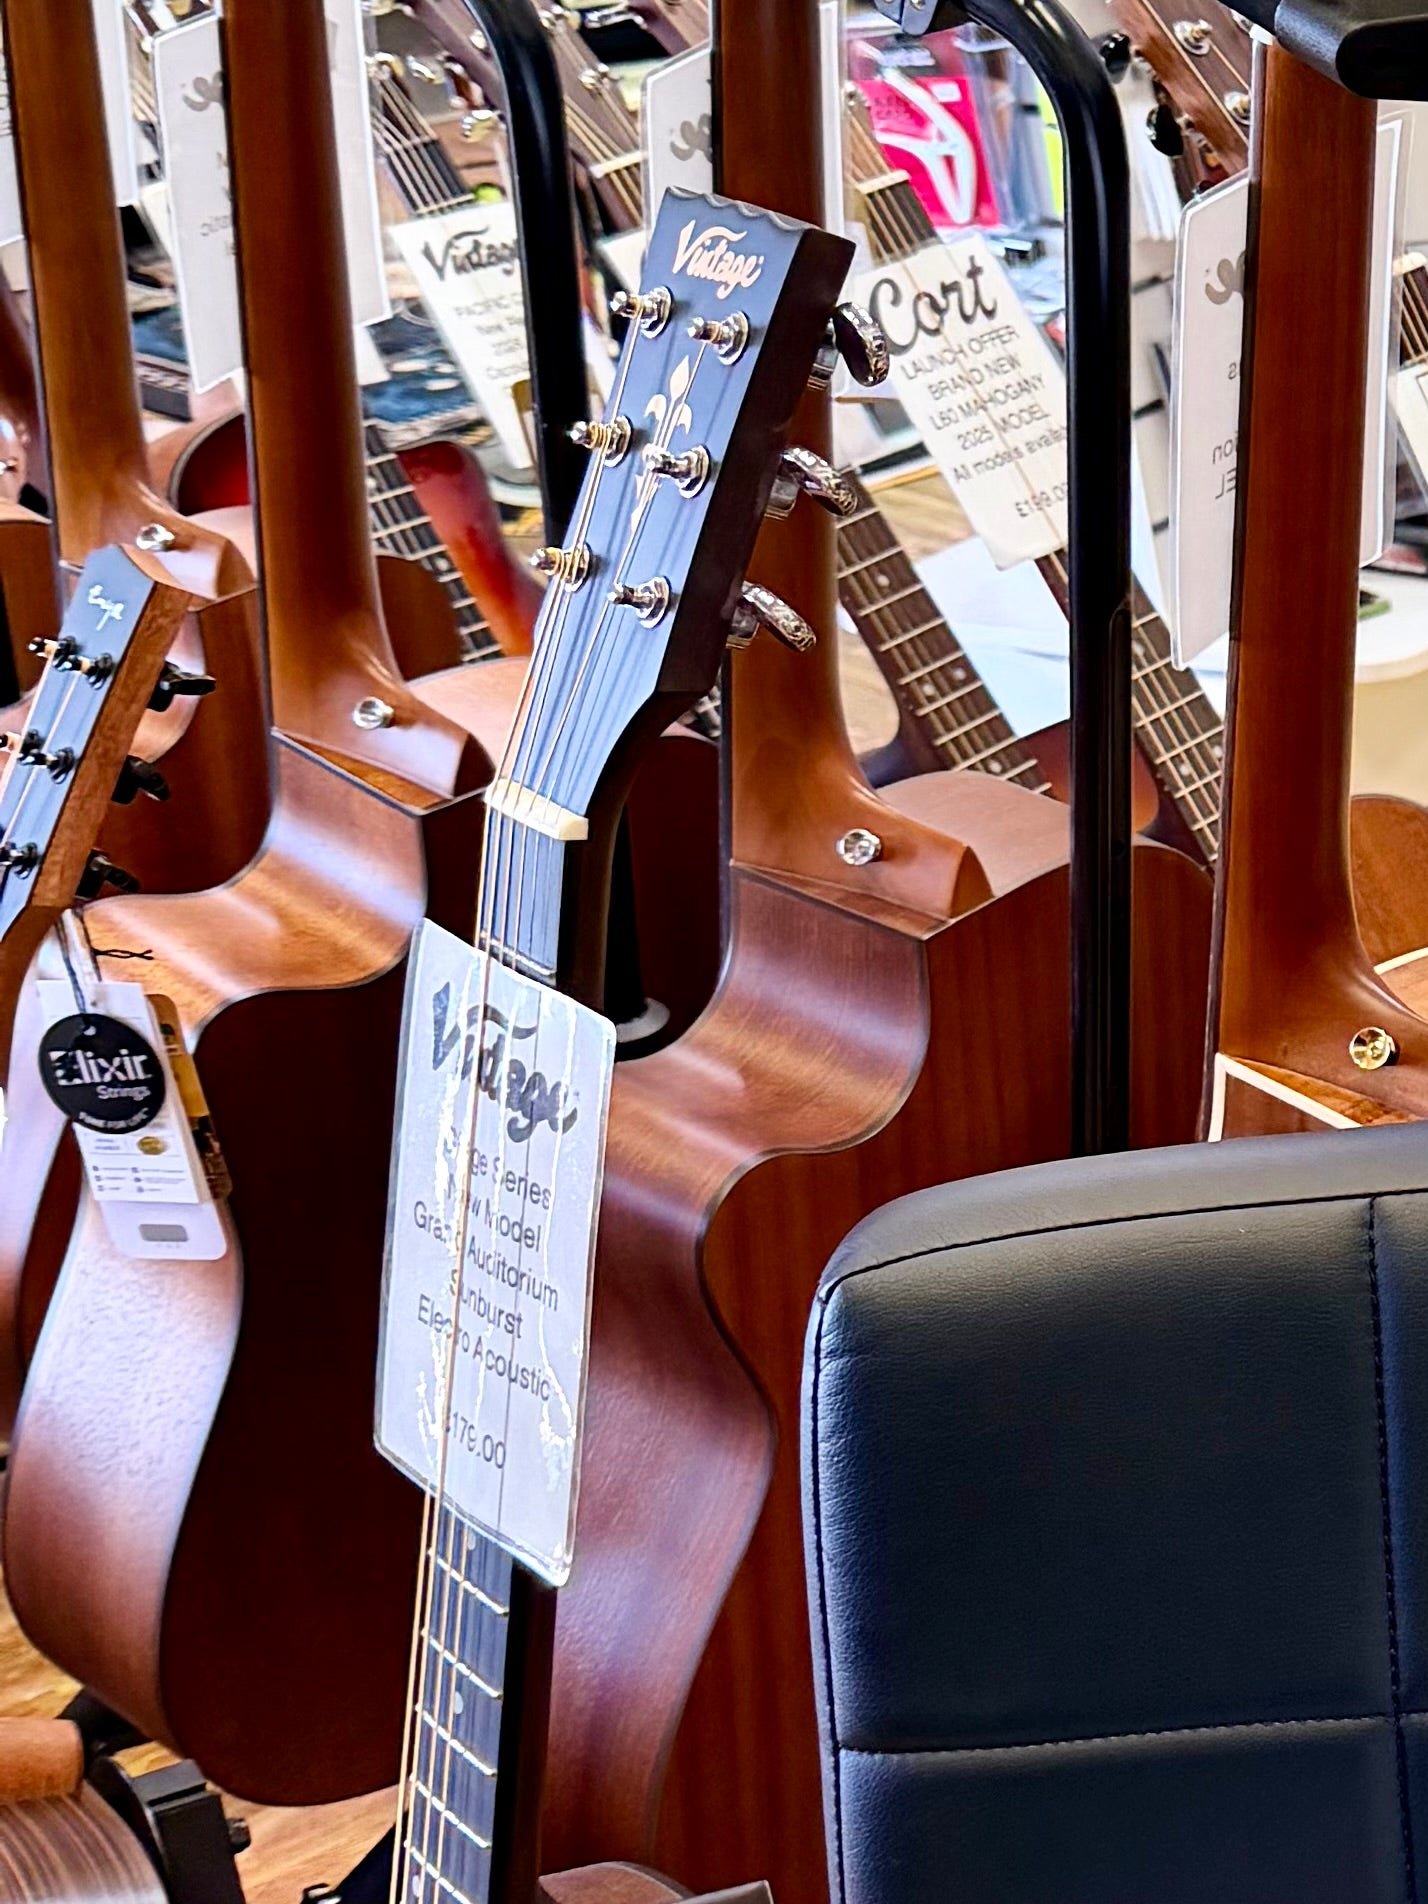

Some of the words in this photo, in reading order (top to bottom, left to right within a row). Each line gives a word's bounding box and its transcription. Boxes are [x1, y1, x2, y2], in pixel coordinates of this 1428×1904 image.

[423, 225, 520, 282] Vintag
[671, 219, 765, 300] Vintage
[869, 254, 998, 357] Cort
[900, 346, 966, 381] LAUNCH
[967, 325, 1020, 353] OFFER
[927, 365, 985, 401] BRAND
[986, 350, 1023, 381] NEW
[960, 373, 1047, 421] MAHOGANY
[997, 403, 1052, 435] MODEL
[48, 1048, 153, 1086] Elixir
[432, 981, 579, 1143] Vintage
[96, 1084, 152, 1102] Strings
[492, 1156, 553, 1211] Series
[485, 1198, 542, 1253] Model
[467, 1235, 560, 1312] Auditorium
[417, 1293, 471, 1354] Elecro
[473, 1335, 551, 1401] Acoustic
[444, 1411, 508, 1469] 179.00
